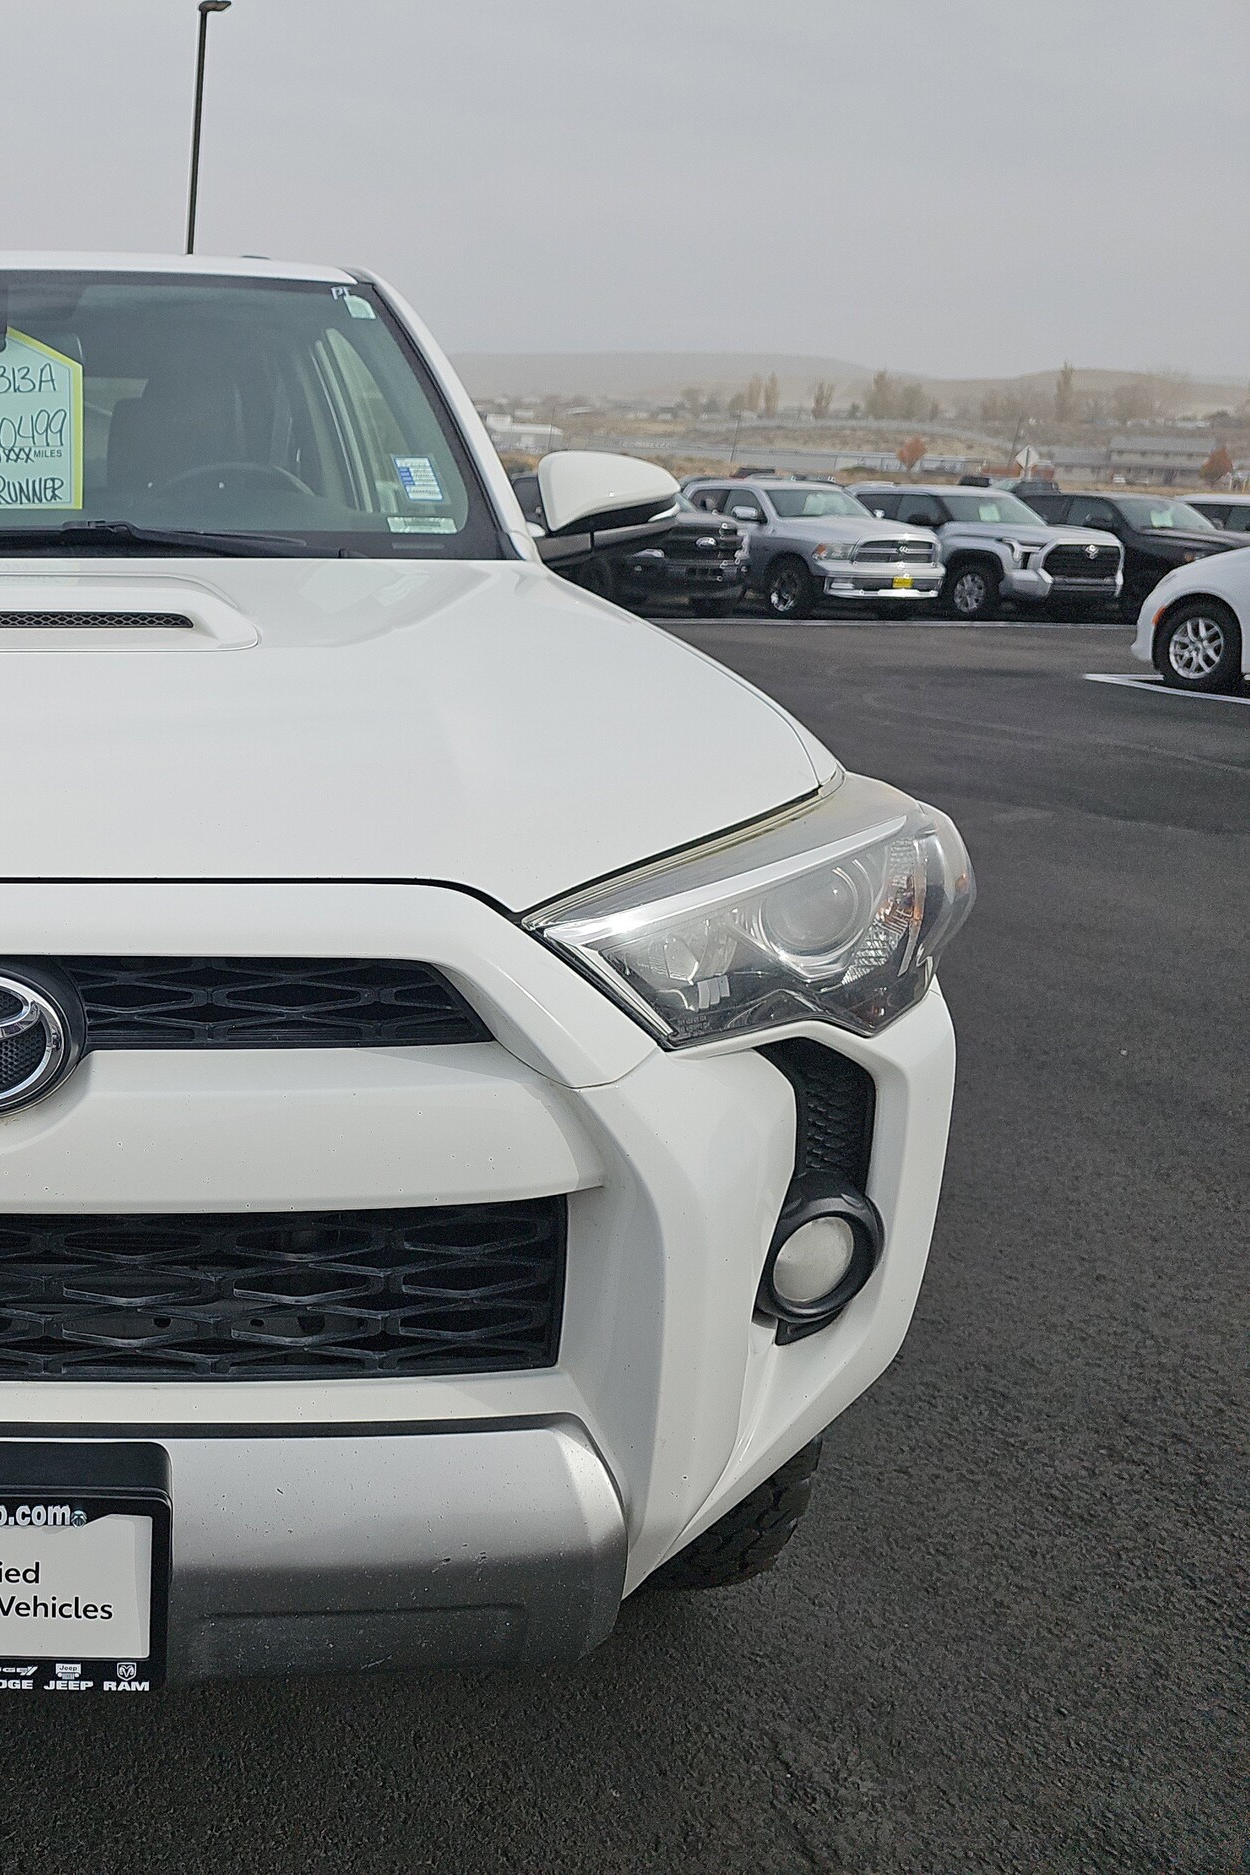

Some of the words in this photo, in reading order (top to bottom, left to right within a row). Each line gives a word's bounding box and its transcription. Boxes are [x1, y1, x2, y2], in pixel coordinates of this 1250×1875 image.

[34, 449, 63, 459] MILES
[43, 1680, 94, 1691] JEEP
[103, 1681, 150, 1692] RAM
